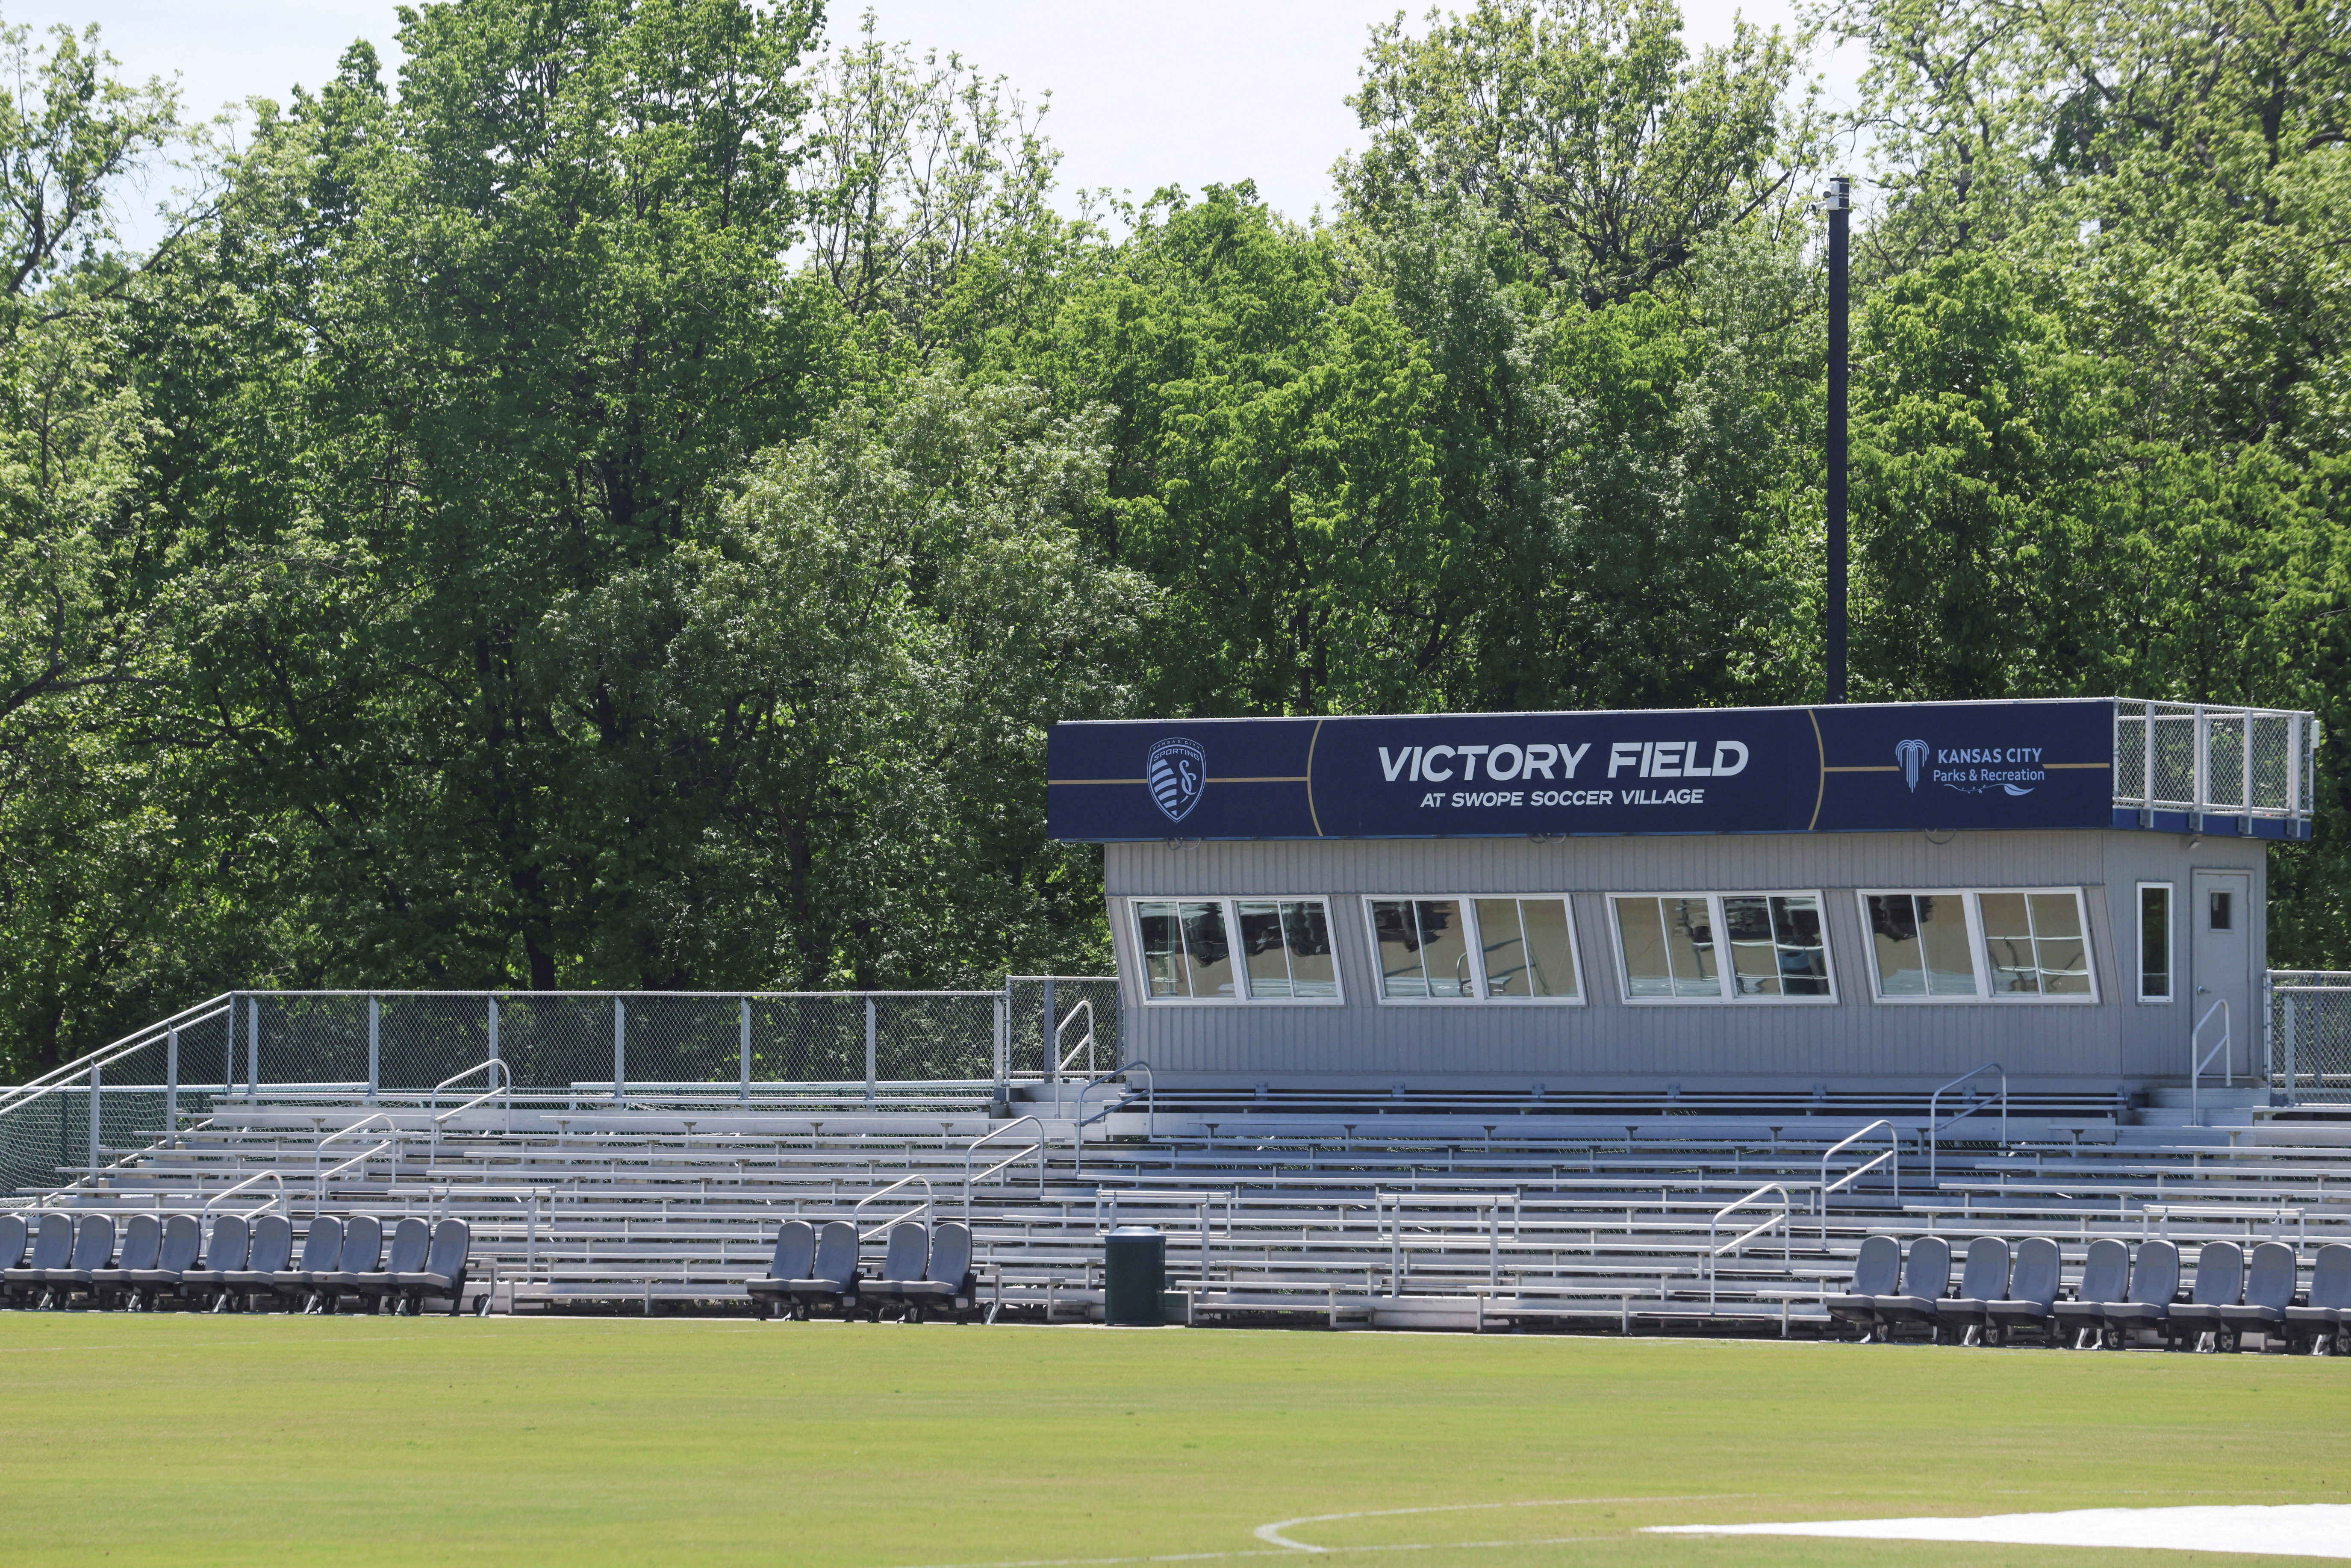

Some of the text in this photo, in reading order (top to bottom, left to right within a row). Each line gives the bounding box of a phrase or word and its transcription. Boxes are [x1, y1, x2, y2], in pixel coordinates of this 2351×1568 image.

[1153, 740, 1200, 751] KANSAS CITY
[1153, 748, 1200, 761] SPORTING
[1378, 740, 1750, 782] VICTORY FIELD
[1938, 748, 2042, 764] KANSAS CITY
[1933, 768, 2045, 782] Parks & Recreation
[1420, 788, 1705, 808] AT SWOPE SOCCER VILLAGE
